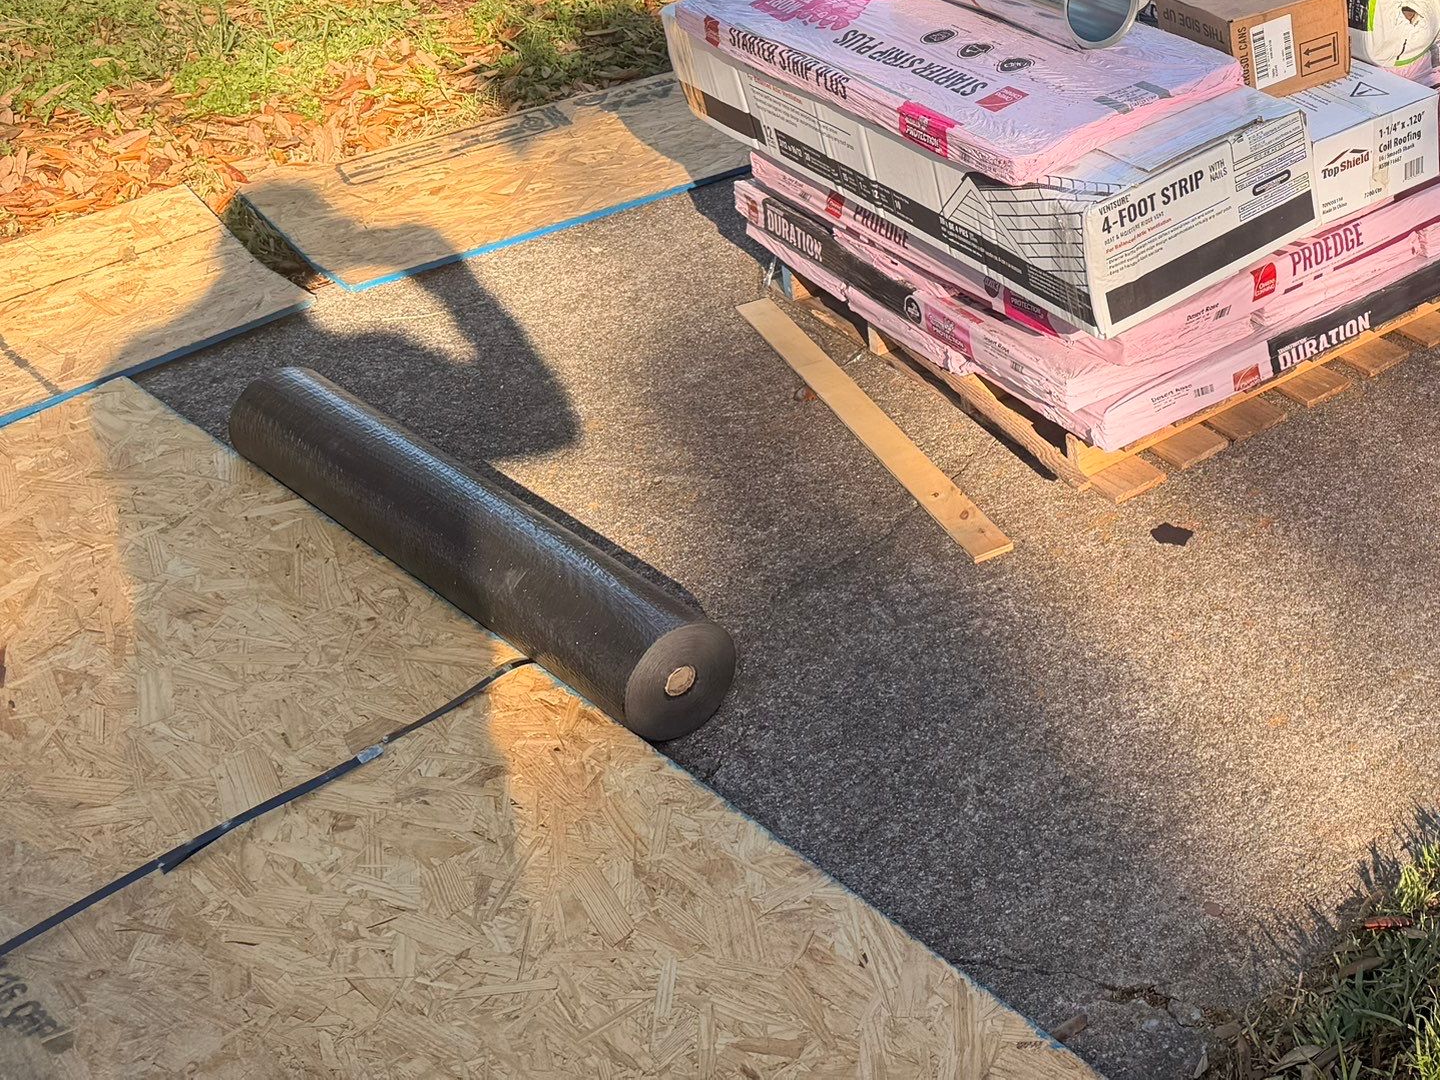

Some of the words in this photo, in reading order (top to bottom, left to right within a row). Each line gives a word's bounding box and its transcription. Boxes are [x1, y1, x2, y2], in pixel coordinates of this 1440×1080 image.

[1162, 6, 1177, 22] UP
[1178, 11, 1201, 33] SIDE
[833, 29, 882, 59] PLUS
[1203, 23, 1226, 46] THIS
[1236, 25, 1248, 52] CANS
[728, 27, 780, 67] STARTER
[779, 48, 816, 82] STRIP
[814, 65, 851, 101] PLUS
[867, 43, 925, 71] STRIP
[911, 57, 989, 97] STARTER
[1378, 120, 1402, 139] 1-1/4"
[1406, 110, 1426, 128] .120"
[1378, 139, 1394, 154] Coil
[1393, 128, 1422, 150] Roofing
[1207, 158, 1226, 175] WITH
[1209, 169, 1229, 183] NAILS
[1098, 194, 1132, 216] VENTSURE
[1101, 192, 1157, 235] 4-FOOT
[1160, 169, 1205, 207] STRIP
[766, 209, 824, 263] DURATION
[854, 204, 910, 251] PROEDGE
[1288, 222, 1364, 277] PROEDGE
[1010, 296, 1043, 315] PROTECTION
[1186, 309, 1205, 322] Desert
[1205, 302, 1220, 314] Rose
[1278, 311, 1373, 370] DURATION
[1150, 389, 1175, 404] Desert
[1175, 383, 1193, 395] Rose
